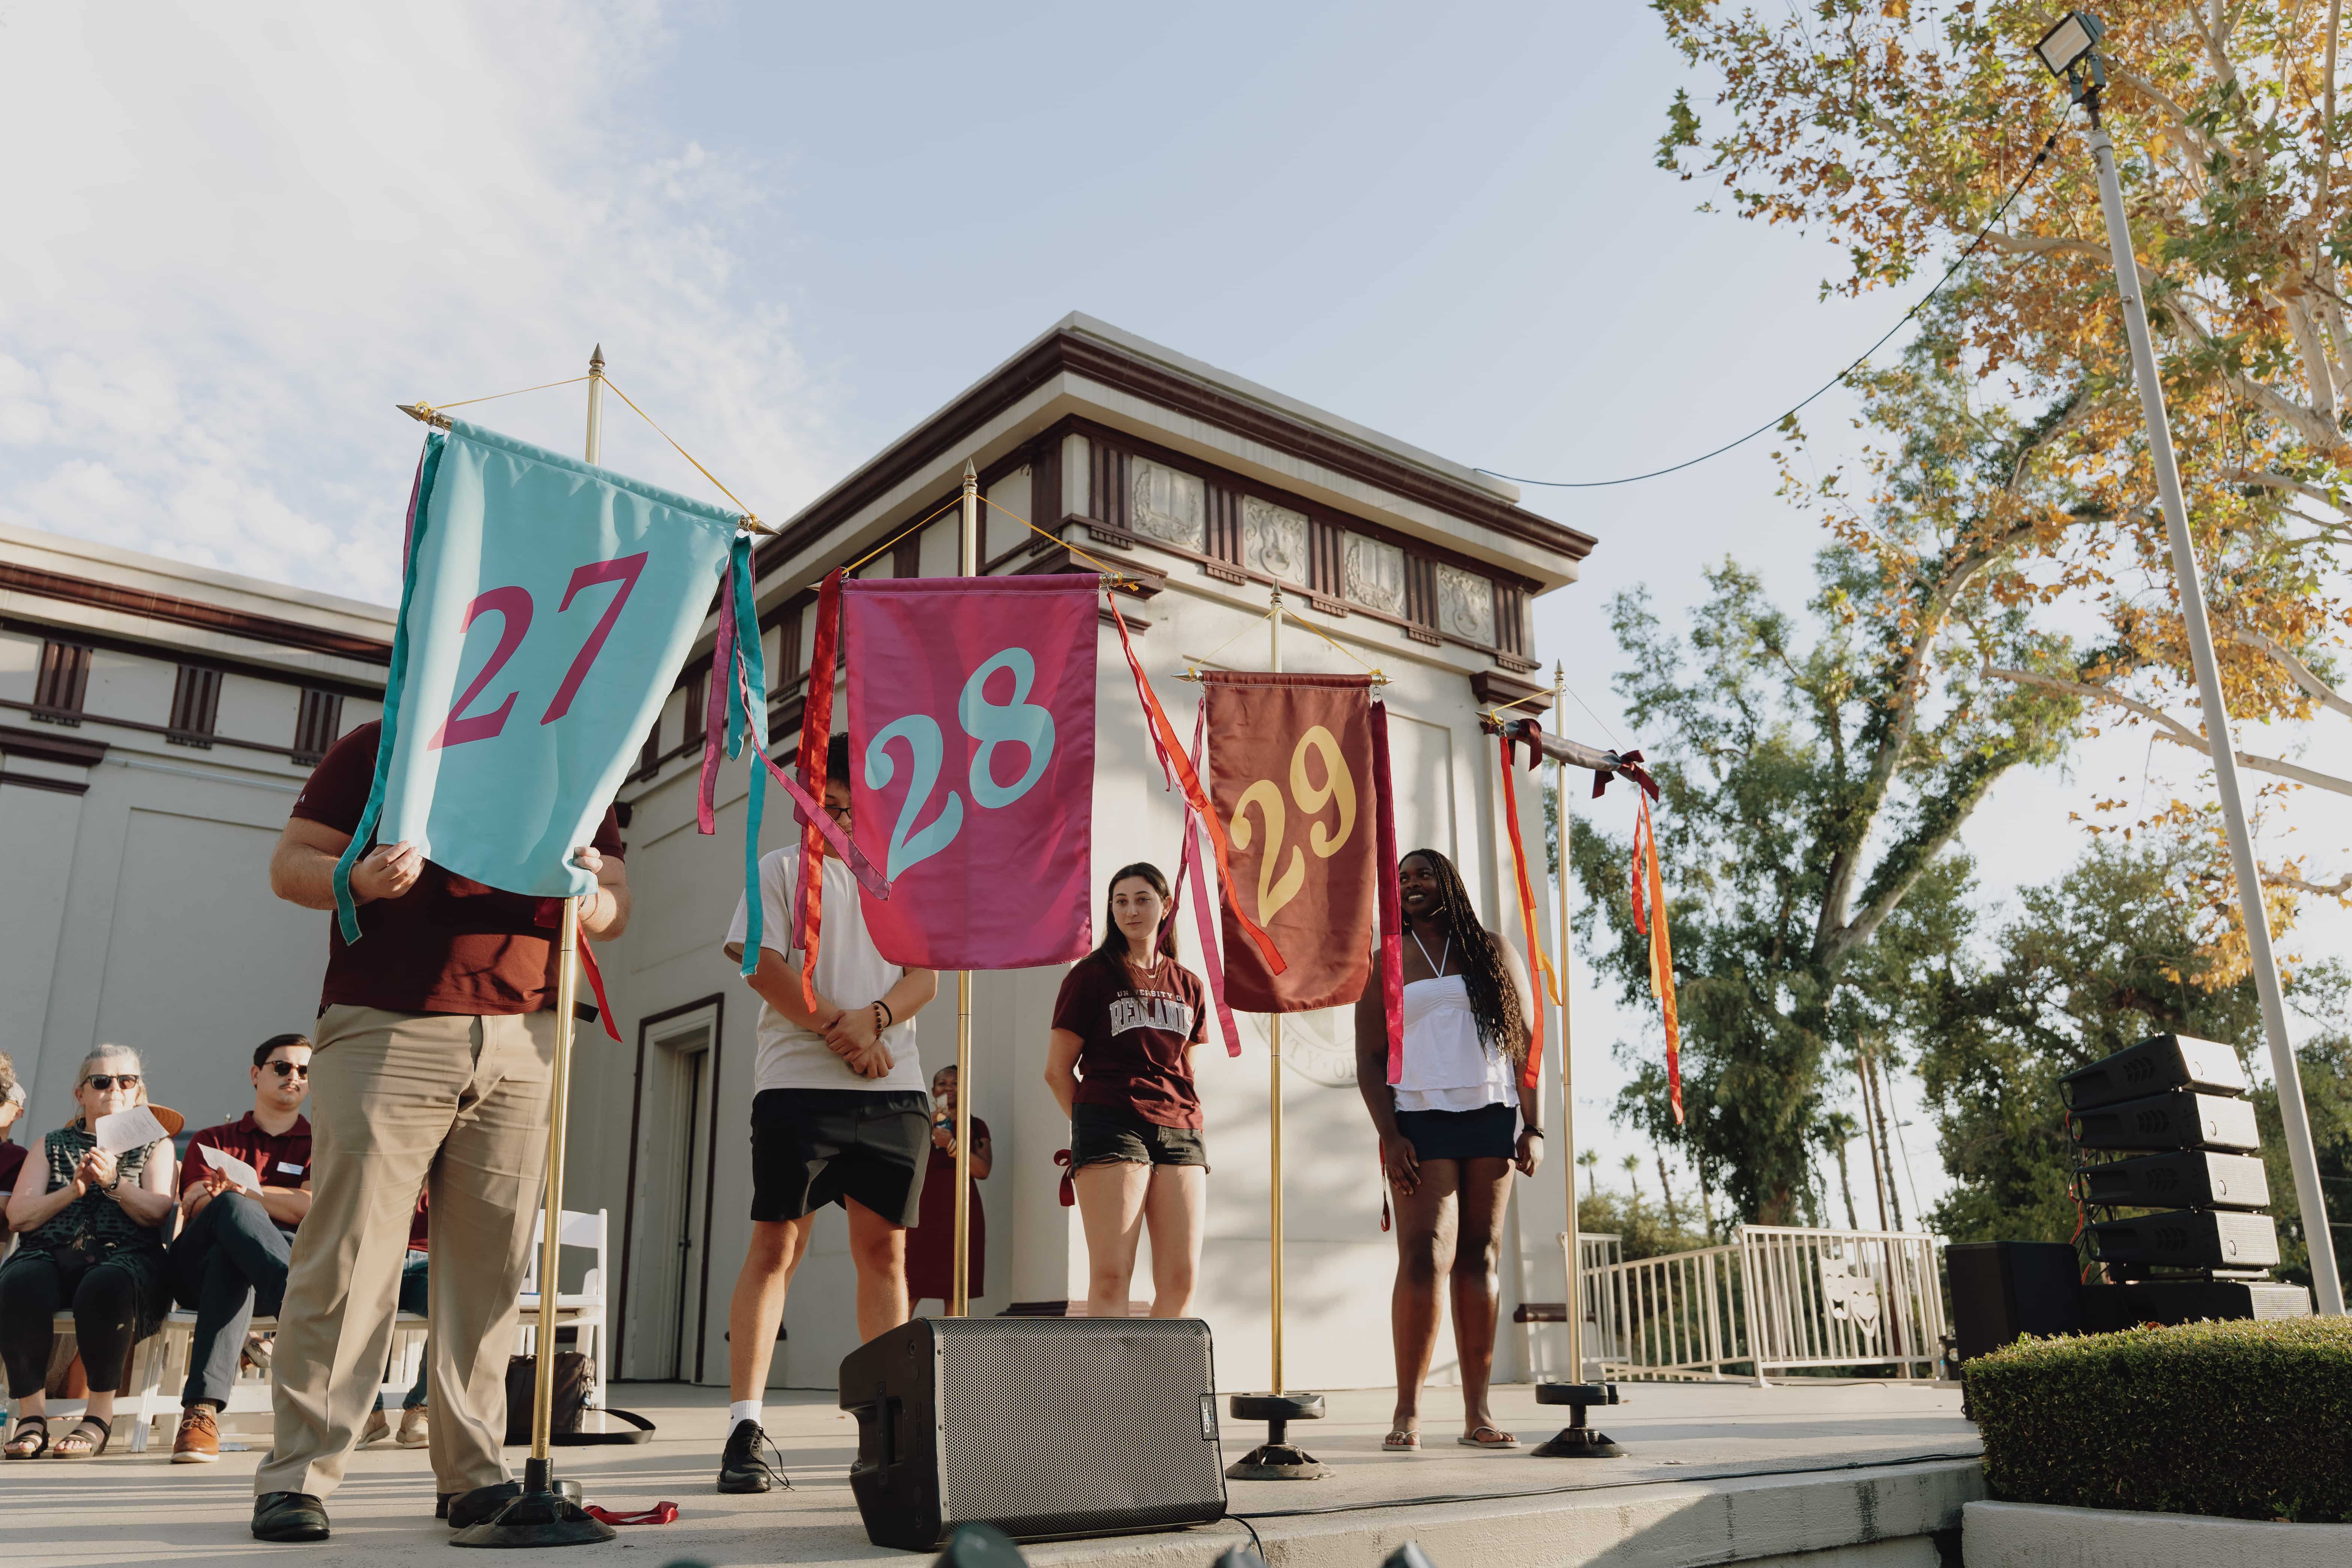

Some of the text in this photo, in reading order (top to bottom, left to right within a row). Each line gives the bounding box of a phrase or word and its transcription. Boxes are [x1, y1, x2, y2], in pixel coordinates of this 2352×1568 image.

[427, 550, 649, 752] 27
[865, 647, 1056, 883] 28
[1230, 725, 1356, 928] 29
[1110, 997, 1194, 1041] REDLANDS
[1117, 989, 1173, 999] UNVERSITY
